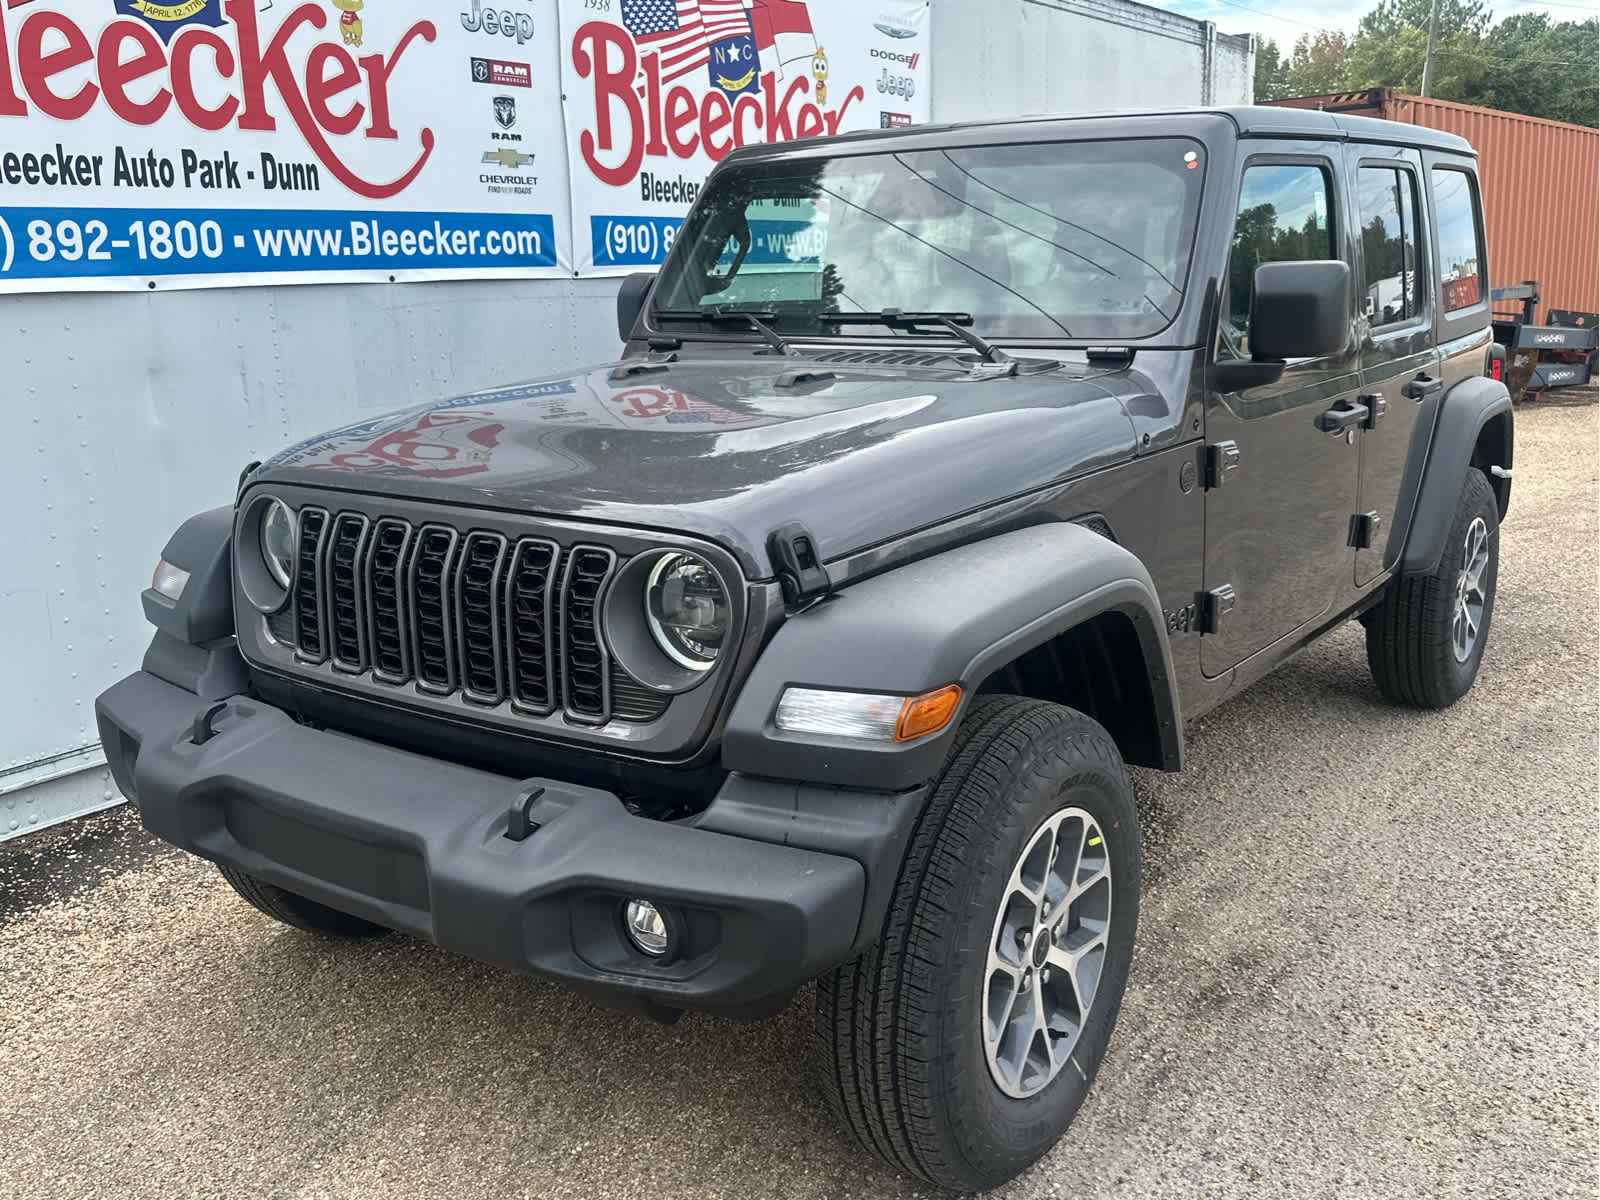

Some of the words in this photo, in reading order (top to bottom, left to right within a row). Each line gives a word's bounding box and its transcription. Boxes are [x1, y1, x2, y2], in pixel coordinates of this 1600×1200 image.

[147, 6, 171, 18] APRIL
[460, 0, 534, 45] Jeep
[493, 64, 528, 76] RAM
[870, 48, 913, 65] DODGE
[876, 67, 915, 102] Jeep
[572, 20, 864, 187] Bleecker
[491, 132, 522, 141] RAM
[0, 144, 102, 186] eecker
[113, 146, 175, 188] Auto
[181, 148, 242, 189] Park
[260, 152, 320, 191] Dunn
[479, 174, 538, 185] CHEVROLET
[640, 172, 700, 203] Bleecker
[27, 219, 224, 262] 892-1800
[253, 219, 541, 257] www.Bleecker.com
[604, 220, 658, 261] (910)
